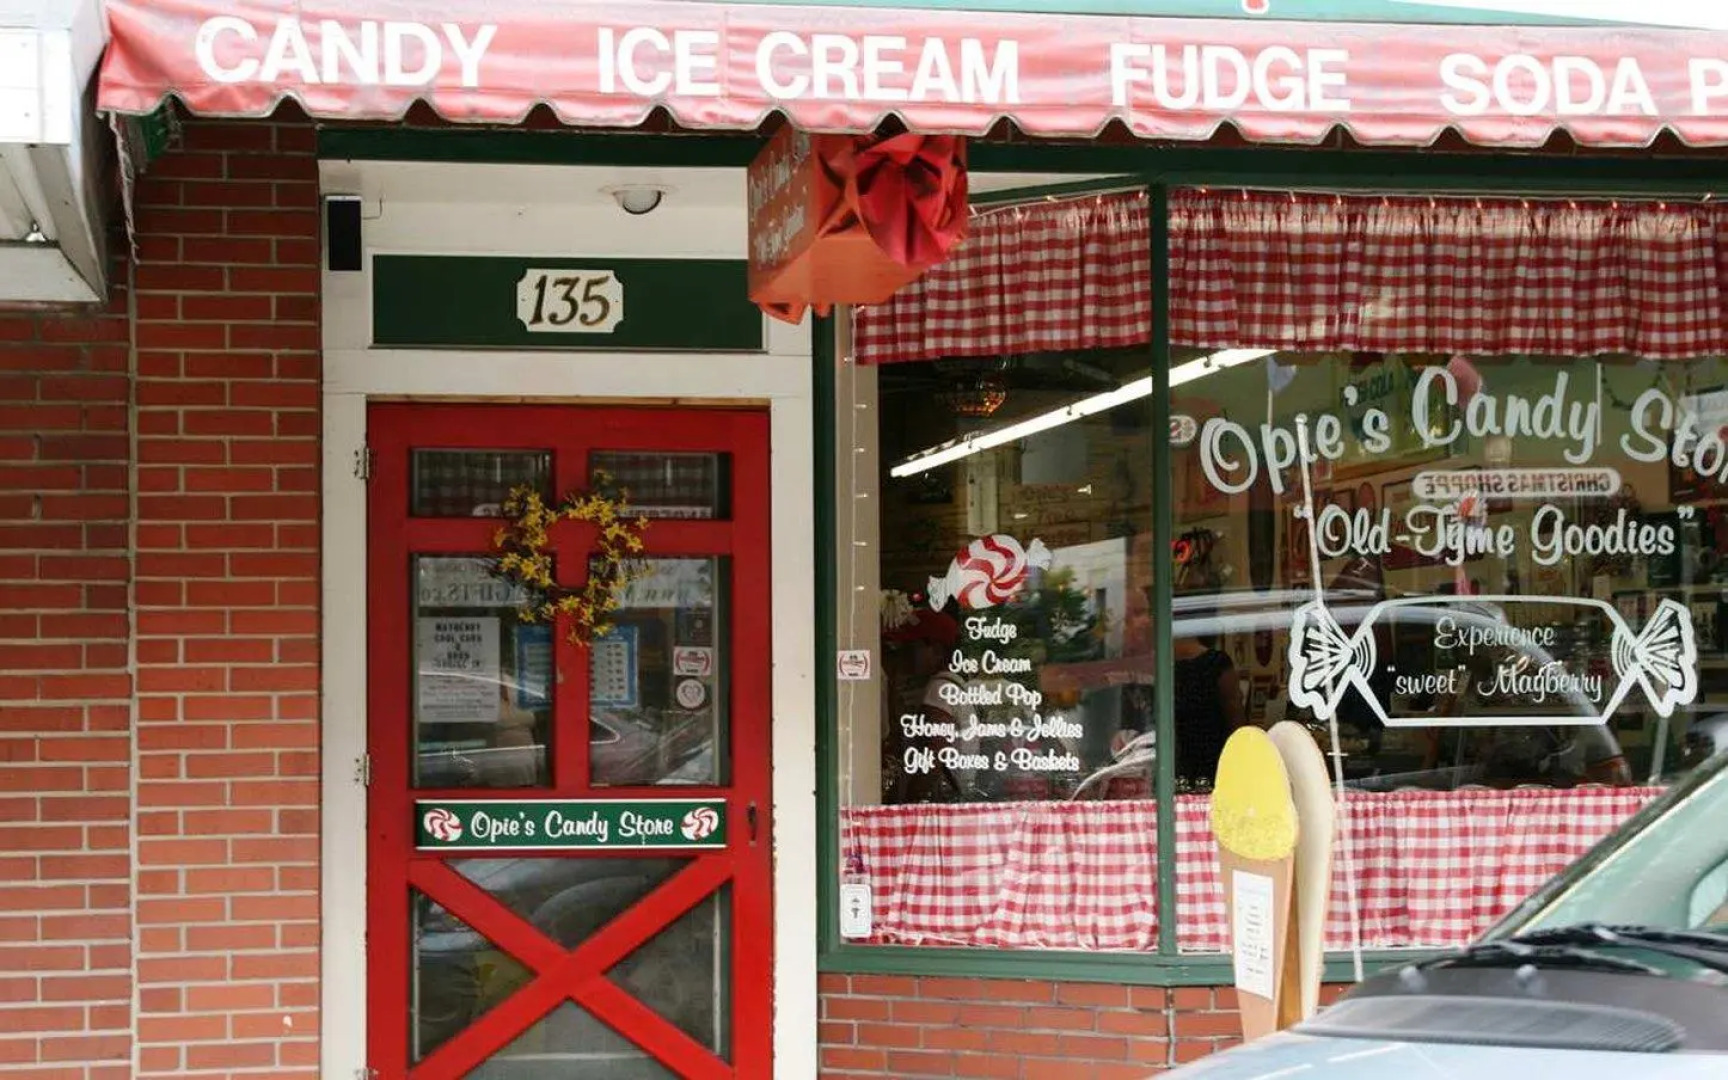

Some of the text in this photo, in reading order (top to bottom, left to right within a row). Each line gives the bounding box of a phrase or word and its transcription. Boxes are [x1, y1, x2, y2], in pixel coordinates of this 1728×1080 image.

[194, 15, 497, 88] CANDY
[598, 27, 720, 97] ICE
[755, 31, 1020, 105] CREAM
[1110, 42, 1351, 113] FUDGE
[1438, 53, 1660, 117] SODA
[528, 274, 611, 327] 135
[1199, 384, 1392, 496] Opie's
[1411, 365, 1598, 465] Candy
[1531, 503, 1696, 567] Goodies"
[964, 615, 1018, 645] Fudge
[1434, 616, 1557, 657] Experience
[948, 648, 1032, 675] Ice Cream
[938, 682, 1043, 710] Bottled Pop
[1387, 659, 1602, 703] "sweet" Mayberry
[962, 713, 1007, 742] Jams
[1009, 716, 1024, 738] &
[1026, 713, 1083, 742] Jellies
[903, 746, 1080, 774] Gift Boxes & Baskets
[469, 810, 675, 843] Opie's Candy Store
